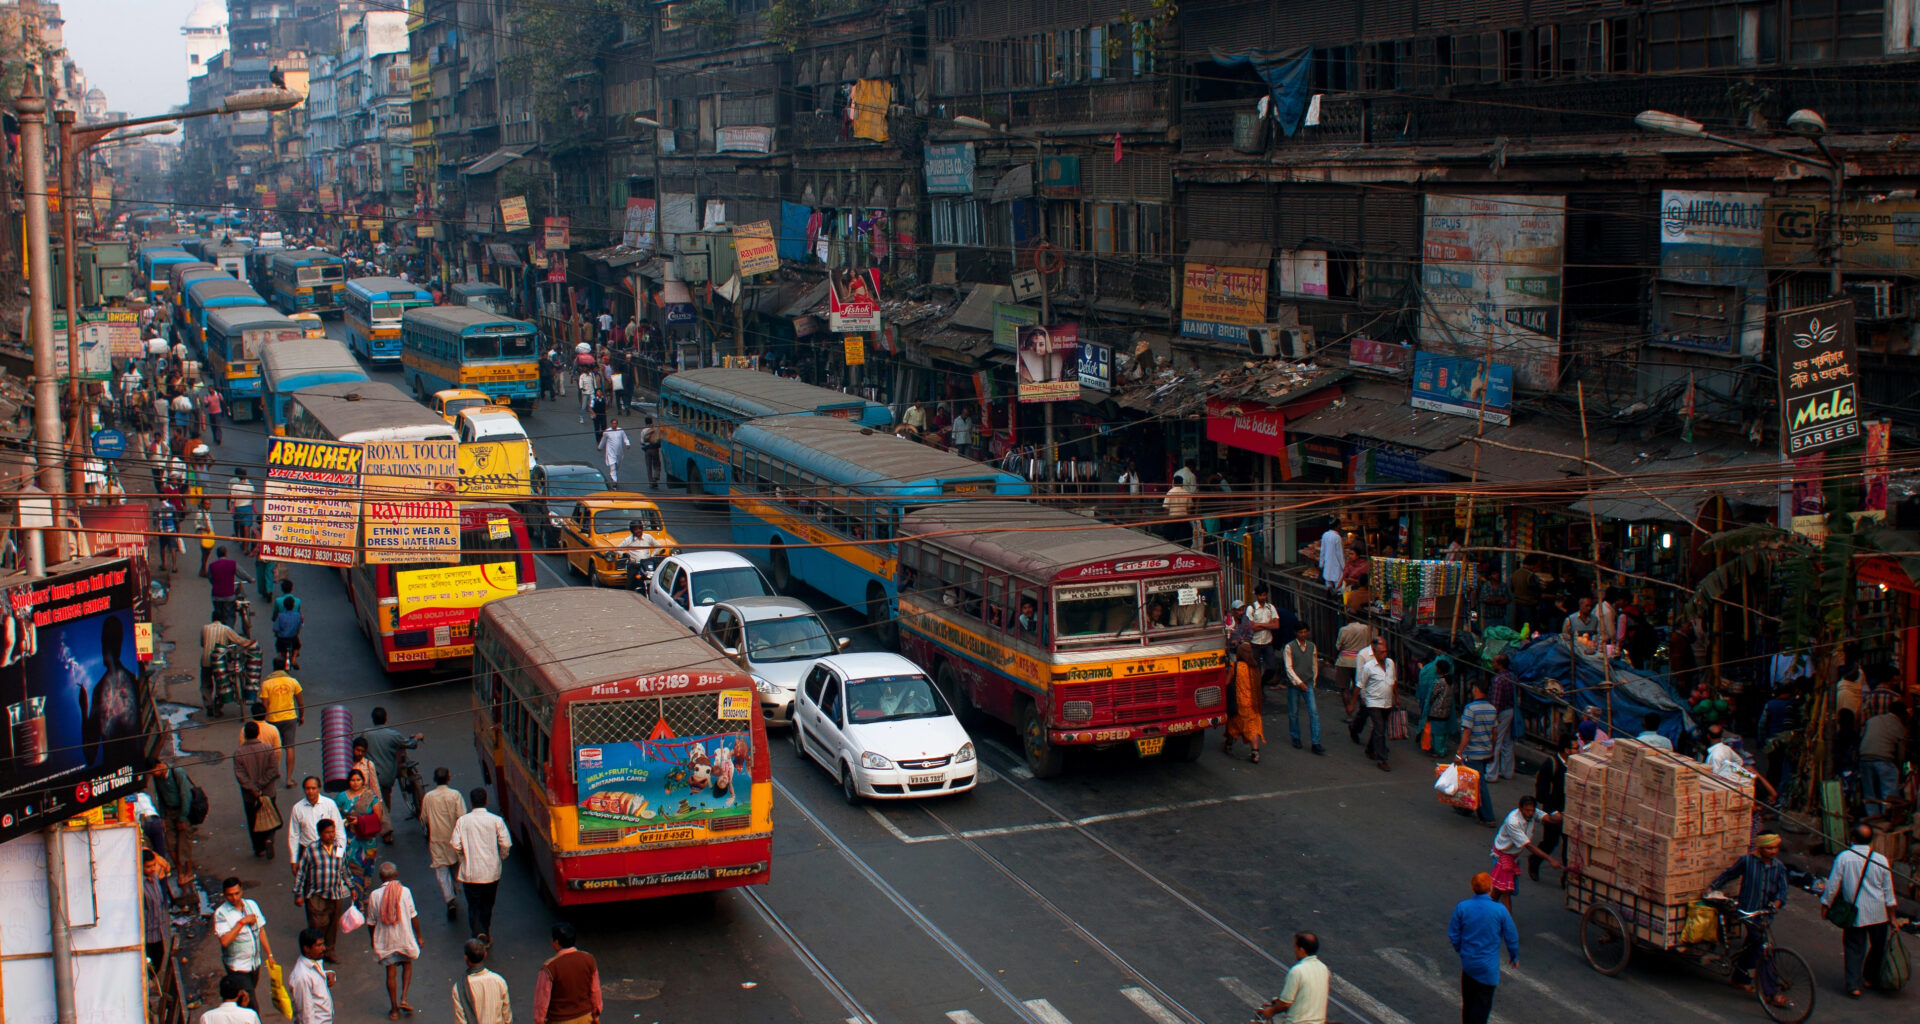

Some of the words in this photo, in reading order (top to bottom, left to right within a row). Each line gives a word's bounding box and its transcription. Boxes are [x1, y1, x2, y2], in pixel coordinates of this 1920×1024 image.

[1183, 321, 1214, 336] NANDY
[1218, 324, 1249, 339] BROTH
[1523, 311, 1547, 333] BLACK
[1793, 389, 1854, 430] Mala
[1252, 415, 1278, 437] baked
[1793, 424, 1856, 449] SAREES
[269, 440, 362, 473] ABHISHEK
[367, 444, 409, 460] ROYAL
[413, 444, 457, 460] TOUCH
[366, 463, 422, 476] CREATIONS
[295, 485, 325, 495] HOUSE
[327, 488, 339, 496] OF
[268, 503, 295, 513] DHOTI
[371, 500, 453, 526] Raymond
[265, 513, 286, 523] SUIT
[327, 520, 355, 530] DRESS
[373, 526, 410, 536] ETHNIC
[412, 526, 441, 535] WEAR
[443, 526, 451, 535] &
[367, 537, 399, 546] DRESS
[402, 537, 457, 546] MATERIALS
[76, 578, 90, 596] are
[89, 572, 104, 591] full
[104, 570, 113, 586] of
[33, 610, 52, 627] that
[52, 602, 83, 622] causes
[83, 596, 111, 616] cancer
[424, 611, 444, 619] GOLD
[445, 609, 465, 617] LOAN
[1095, 729, 1131, 742] SPEED
[587, 771, 604, 784] MILK
[608, 767, 629, 776] FRUIT
[633, 768, 649, 777] EGG
[91, 781, 110, 797] QUIT
[110, 775, 133, 791] TODAY
